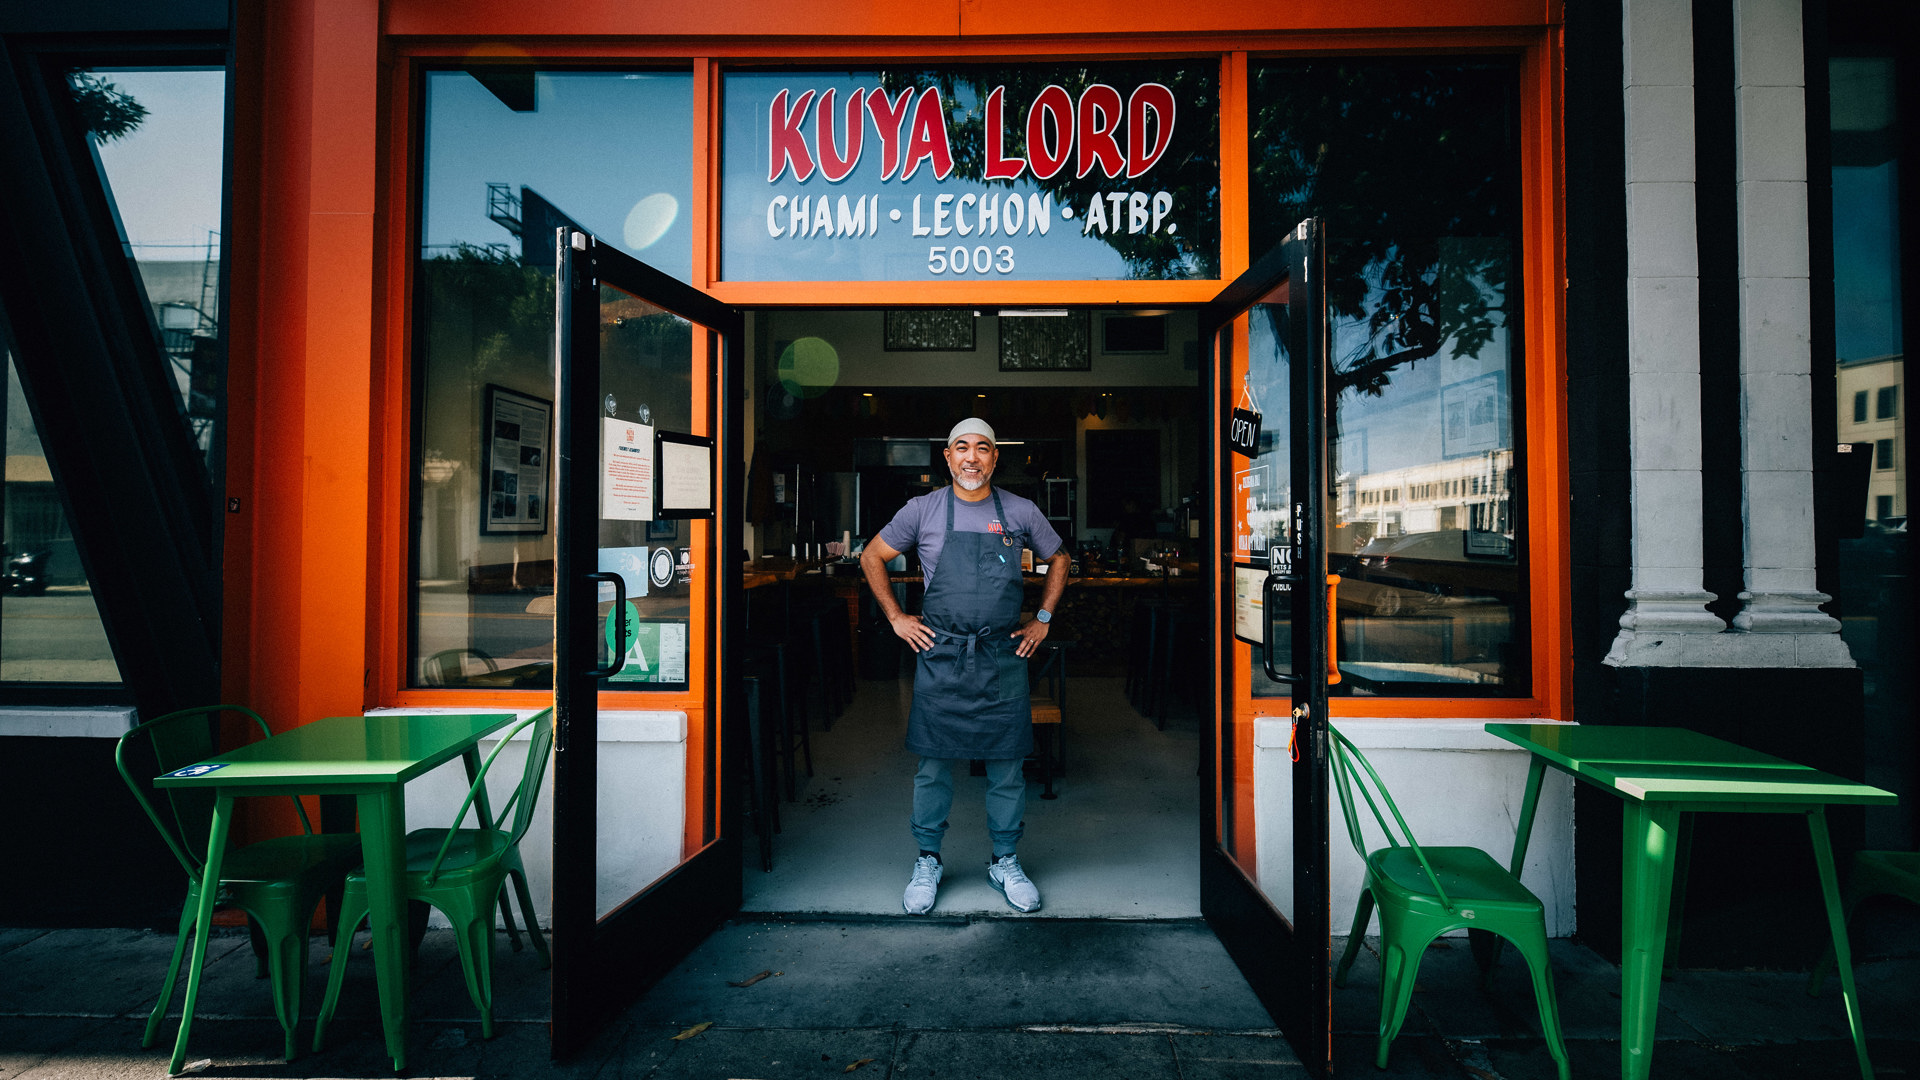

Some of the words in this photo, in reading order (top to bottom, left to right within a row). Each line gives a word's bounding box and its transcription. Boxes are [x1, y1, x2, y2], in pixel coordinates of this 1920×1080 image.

[767, 85, 955, 184] KUYA
[984, 82, 1177, 181] LORD
[766, 193, 880, 239] CHAMI
[911, 191, 1052, 238] LECHON
[1084, 190, 1177, 236] ATBP.
[927, 245, 1016, 275] 5003
[1231, 417, 1256, 447] OPEN
[621, 638, 649, 671] A
